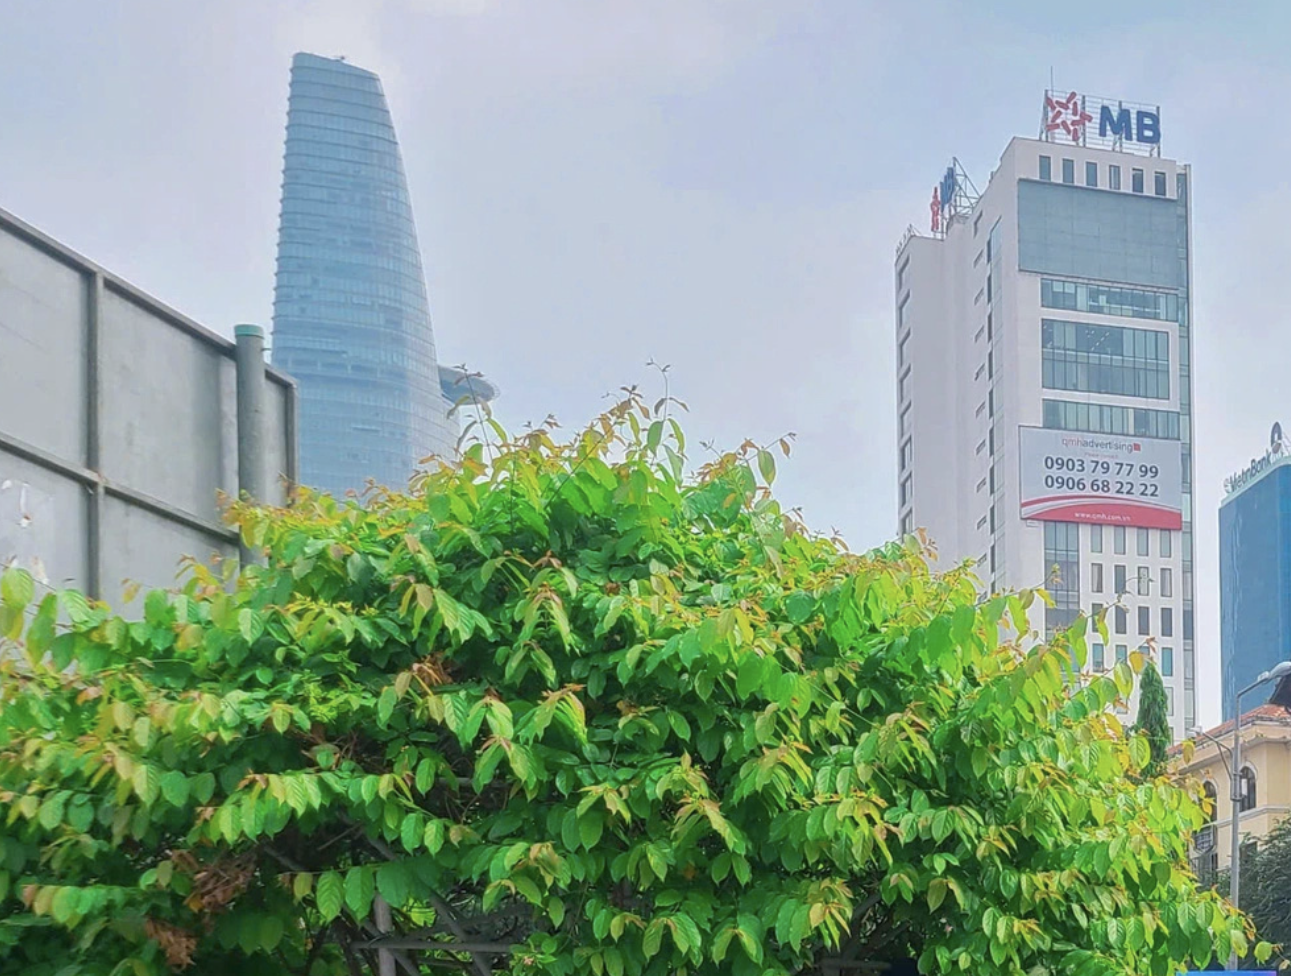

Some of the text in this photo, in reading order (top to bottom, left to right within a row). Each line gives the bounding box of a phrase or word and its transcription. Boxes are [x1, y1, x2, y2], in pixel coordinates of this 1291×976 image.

[1099, 105, 1160, 144] MB
[1044, 456, 1159, 479] 0903 79 77 99
[1044, 475, 1159, 497] 0906 68 22 22
